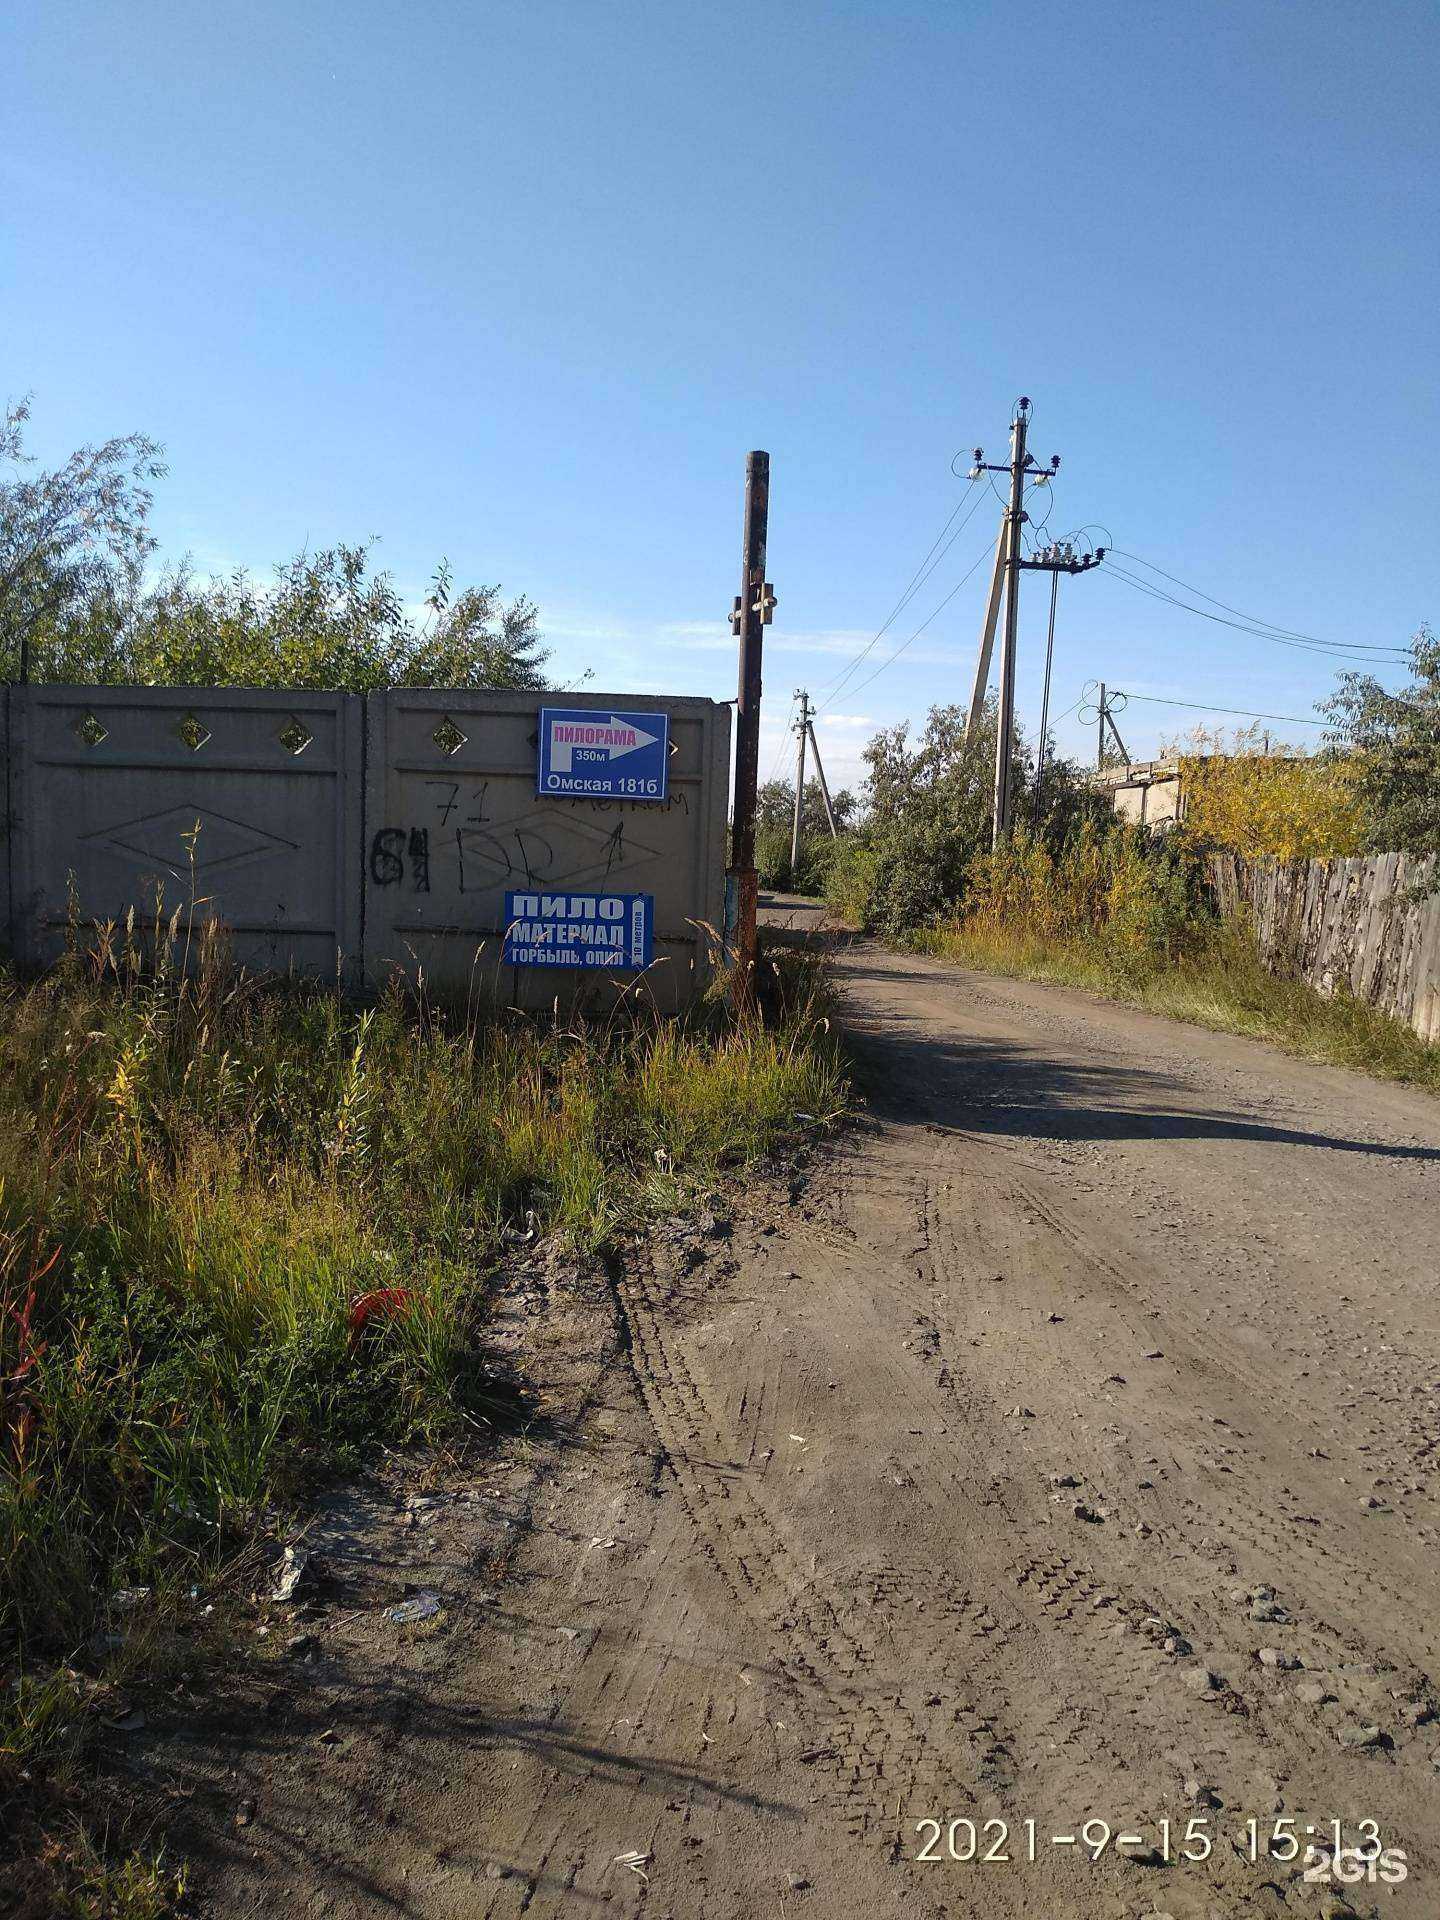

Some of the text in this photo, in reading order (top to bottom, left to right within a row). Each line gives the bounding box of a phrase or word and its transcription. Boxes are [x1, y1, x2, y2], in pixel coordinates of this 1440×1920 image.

[554, 726, 637, 746] ПИЛОРАМА
[575, 749, 606, 762] 350м
[547, 774, 612, 792] Омская
[513, 896, 624, 919] ПИЛО
[512, 923, 623, 945] МАТЕРИАЛ
[512, 948, 624, 966] ГОРБЫЛЬ, ОПИЛ
[633, 947, 642, 957] 10
